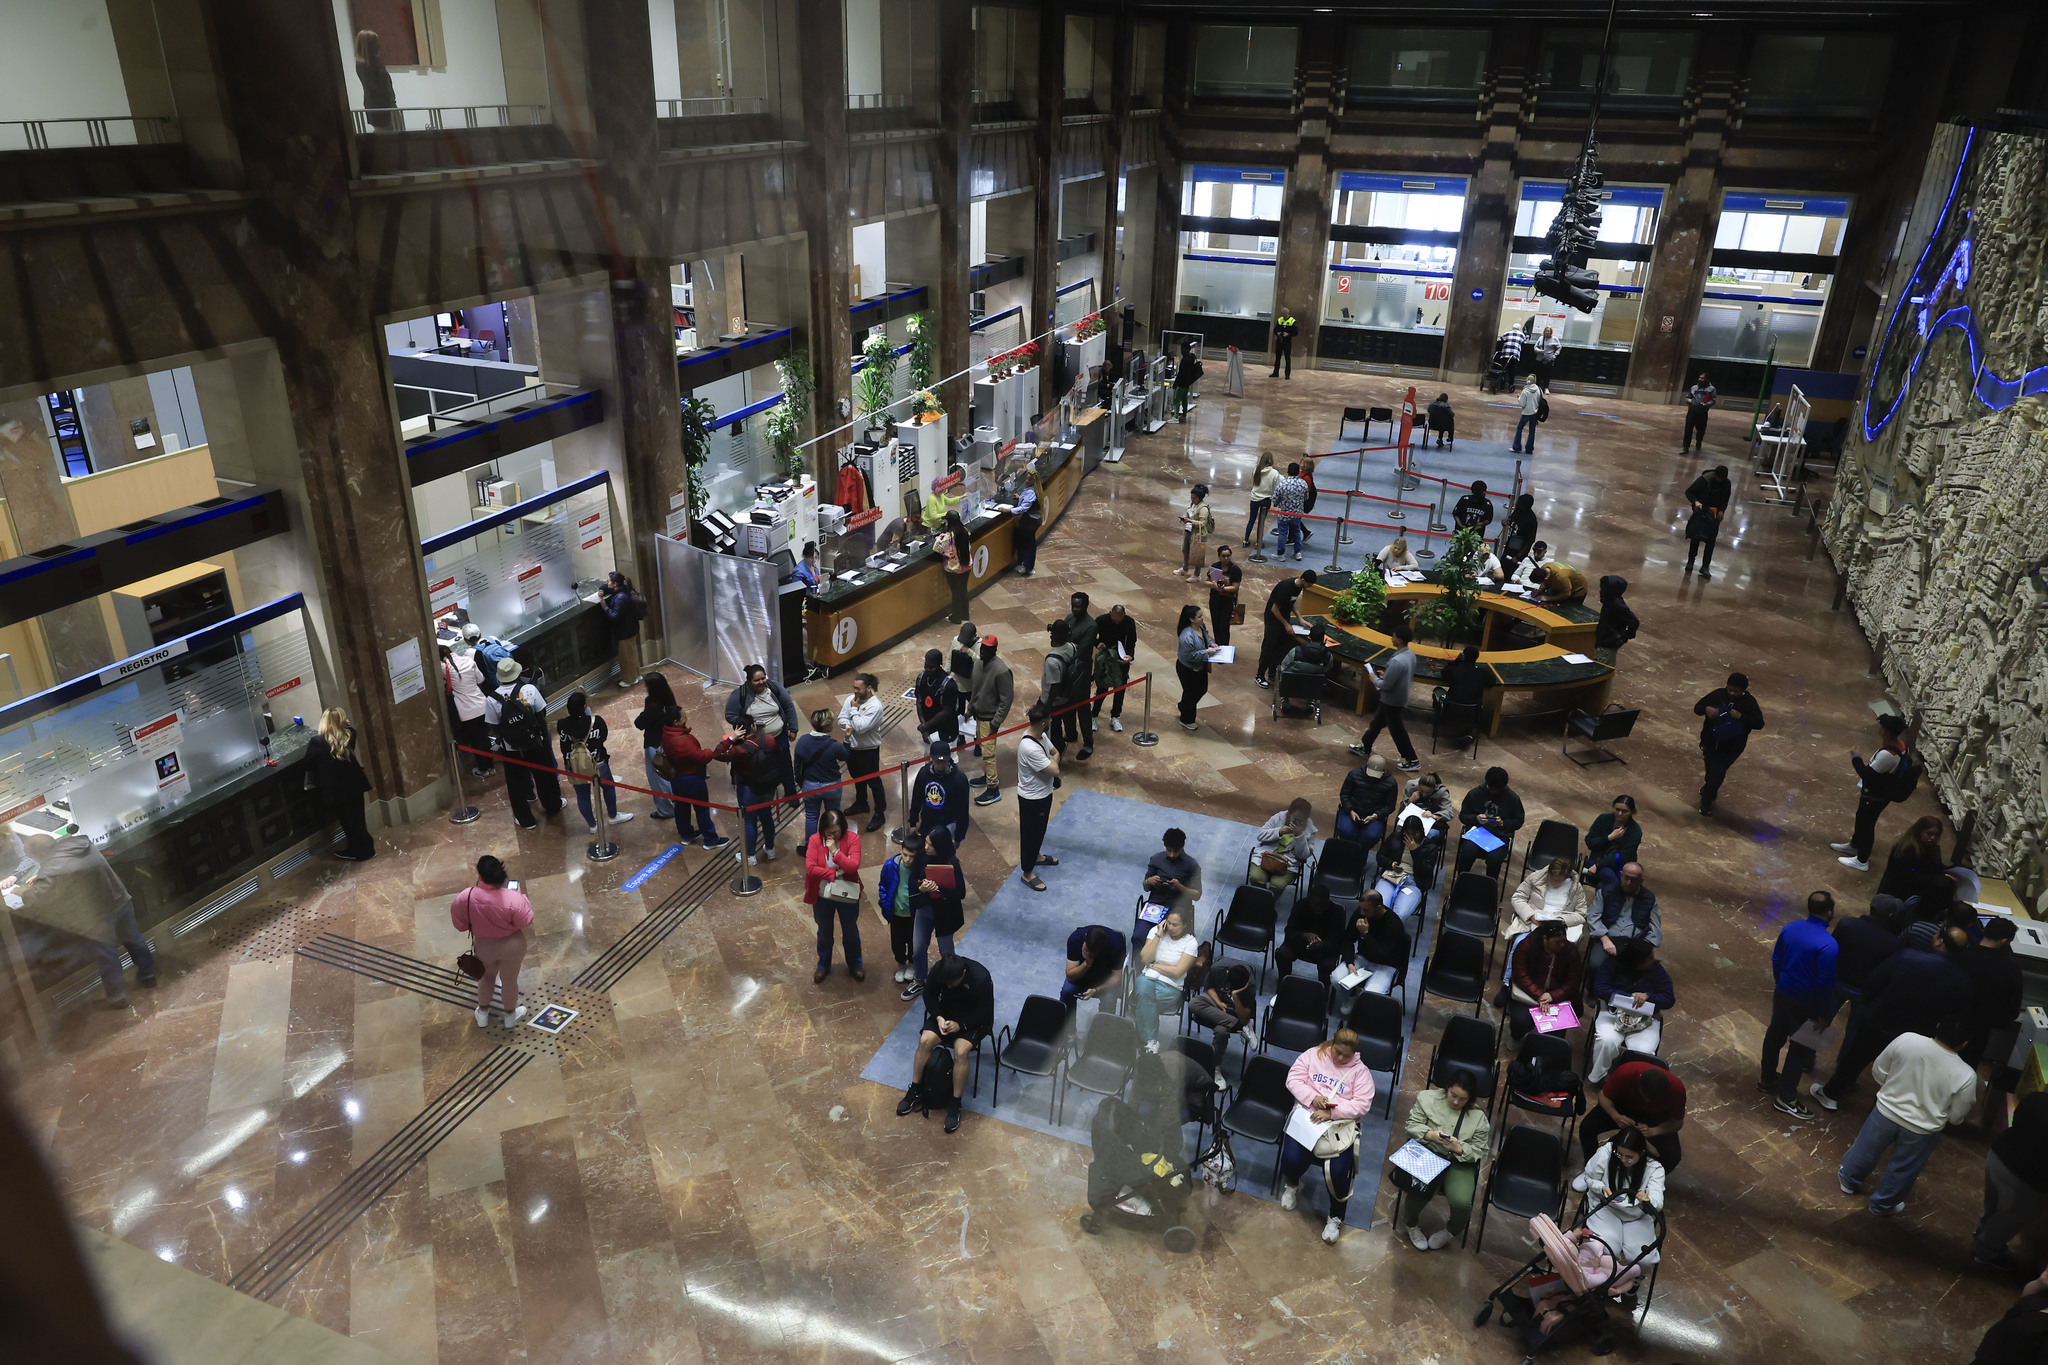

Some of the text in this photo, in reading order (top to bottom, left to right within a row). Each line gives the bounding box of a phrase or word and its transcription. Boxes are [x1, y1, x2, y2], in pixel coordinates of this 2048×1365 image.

[1338, 277, 1350, 292] 9
[1427, 284, 1449, 300] 10
[119, 649, 169, 675] REGISTRO
[134, 805, 166, 823] CERRADA
